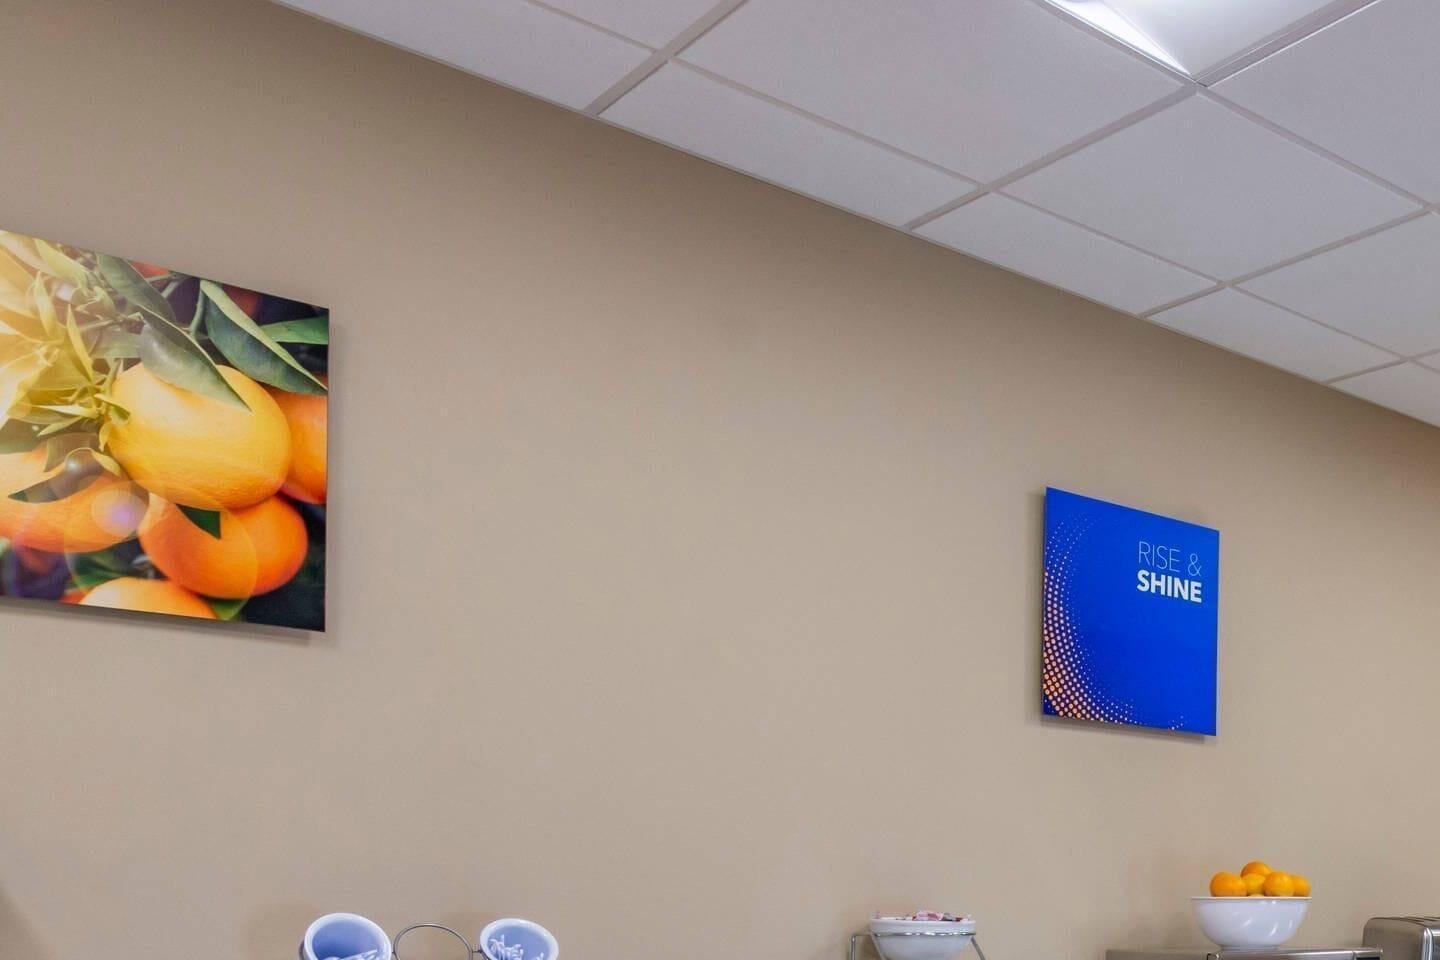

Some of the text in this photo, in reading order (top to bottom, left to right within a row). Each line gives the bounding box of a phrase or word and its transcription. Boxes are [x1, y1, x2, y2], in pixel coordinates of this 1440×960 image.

[1139, 541, 1202, 577] RISE &
[1137, 569, 1202, 603] SHINE
